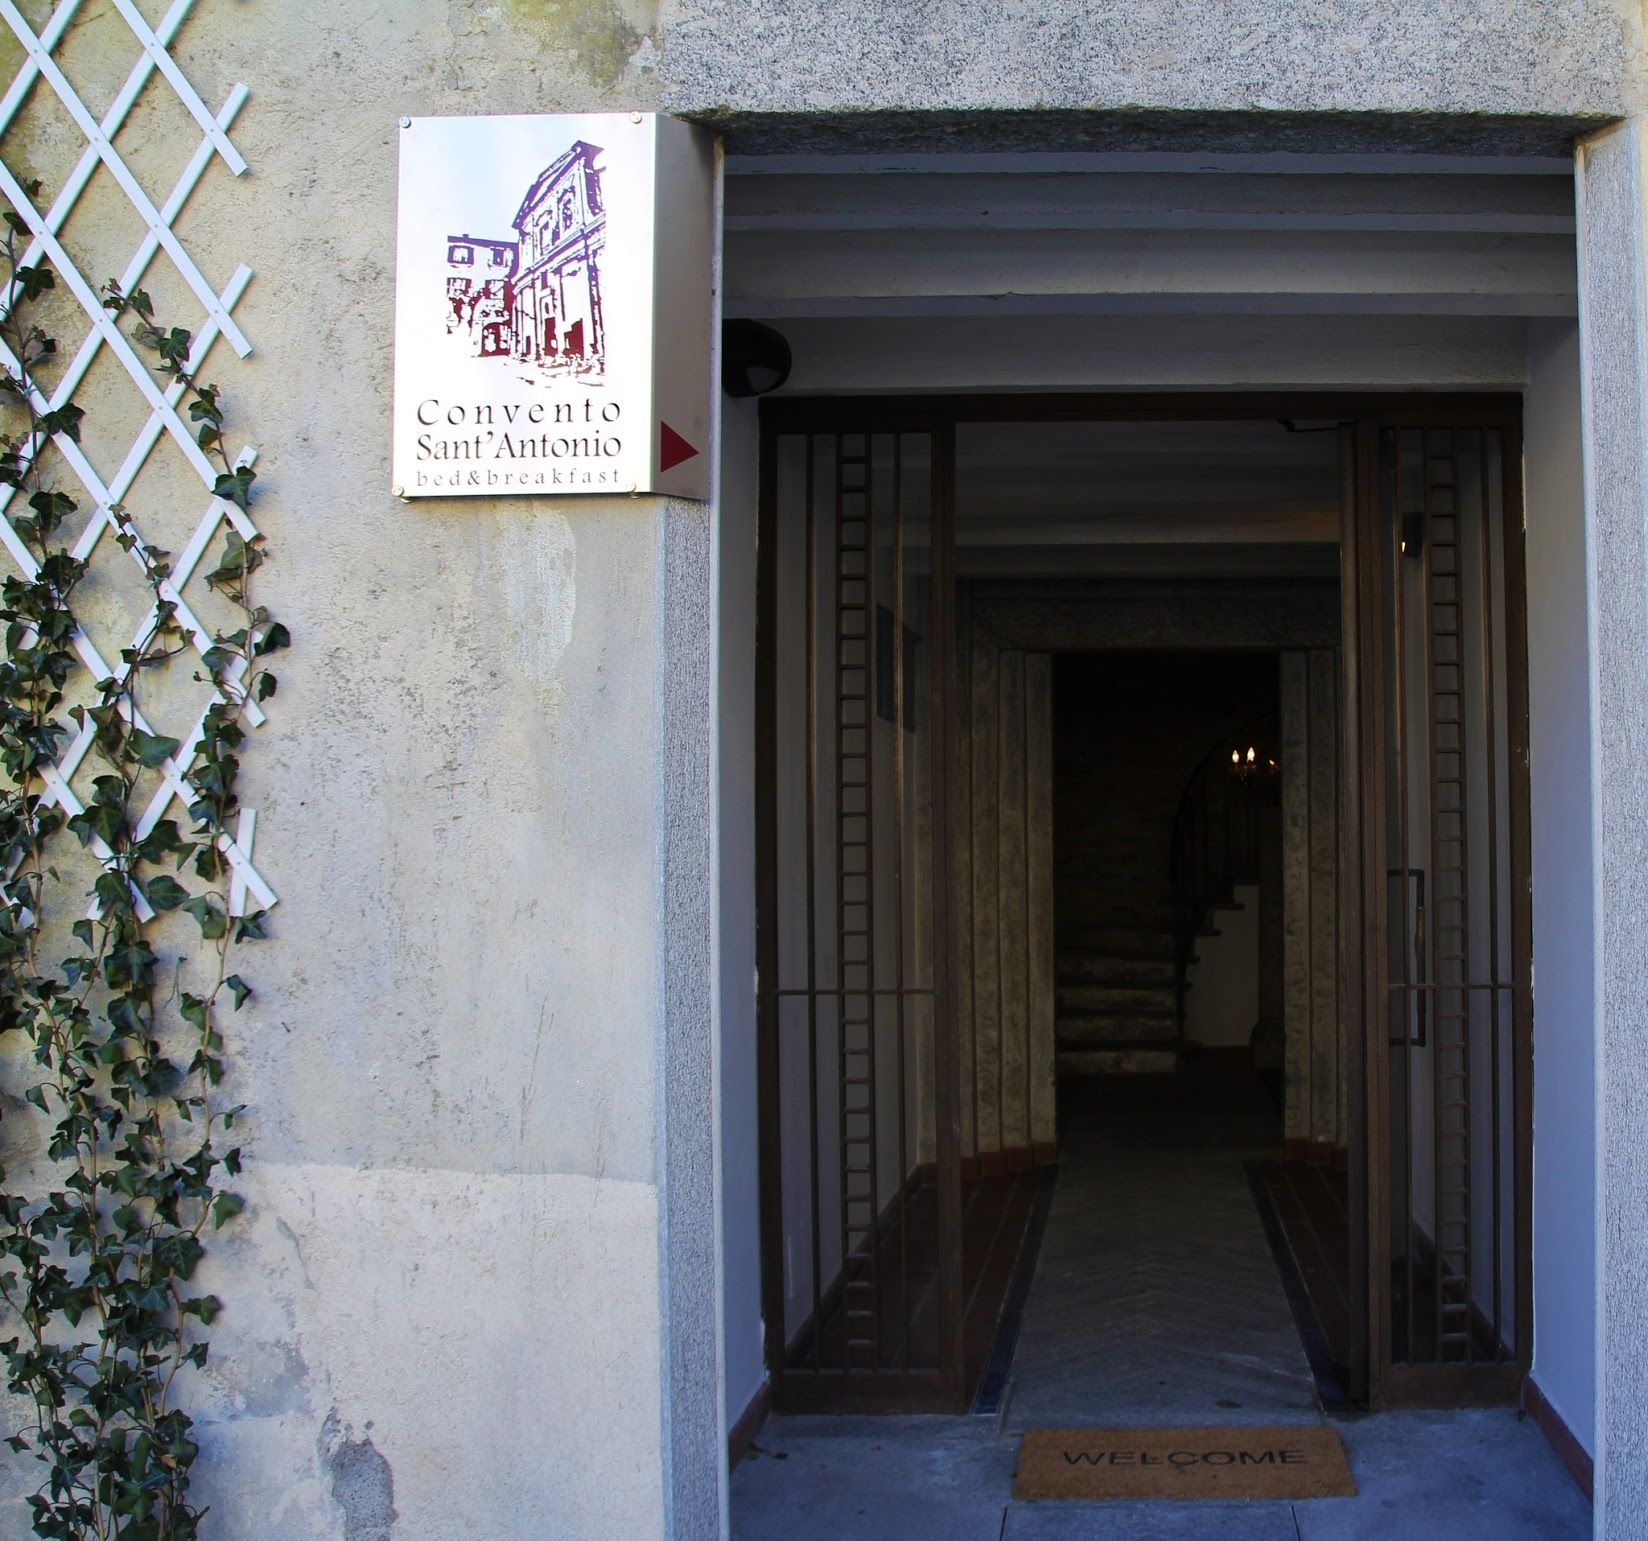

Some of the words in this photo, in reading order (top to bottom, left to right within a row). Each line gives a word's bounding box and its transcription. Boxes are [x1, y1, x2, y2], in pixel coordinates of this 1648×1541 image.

[417, 398, 621, 425] Convento
[417, 430, 621, 460] Sant'Antonio
[416, 468, 619, 487] bed&breakfast
[1062, 1450, 1309, 1466] WELCOME
